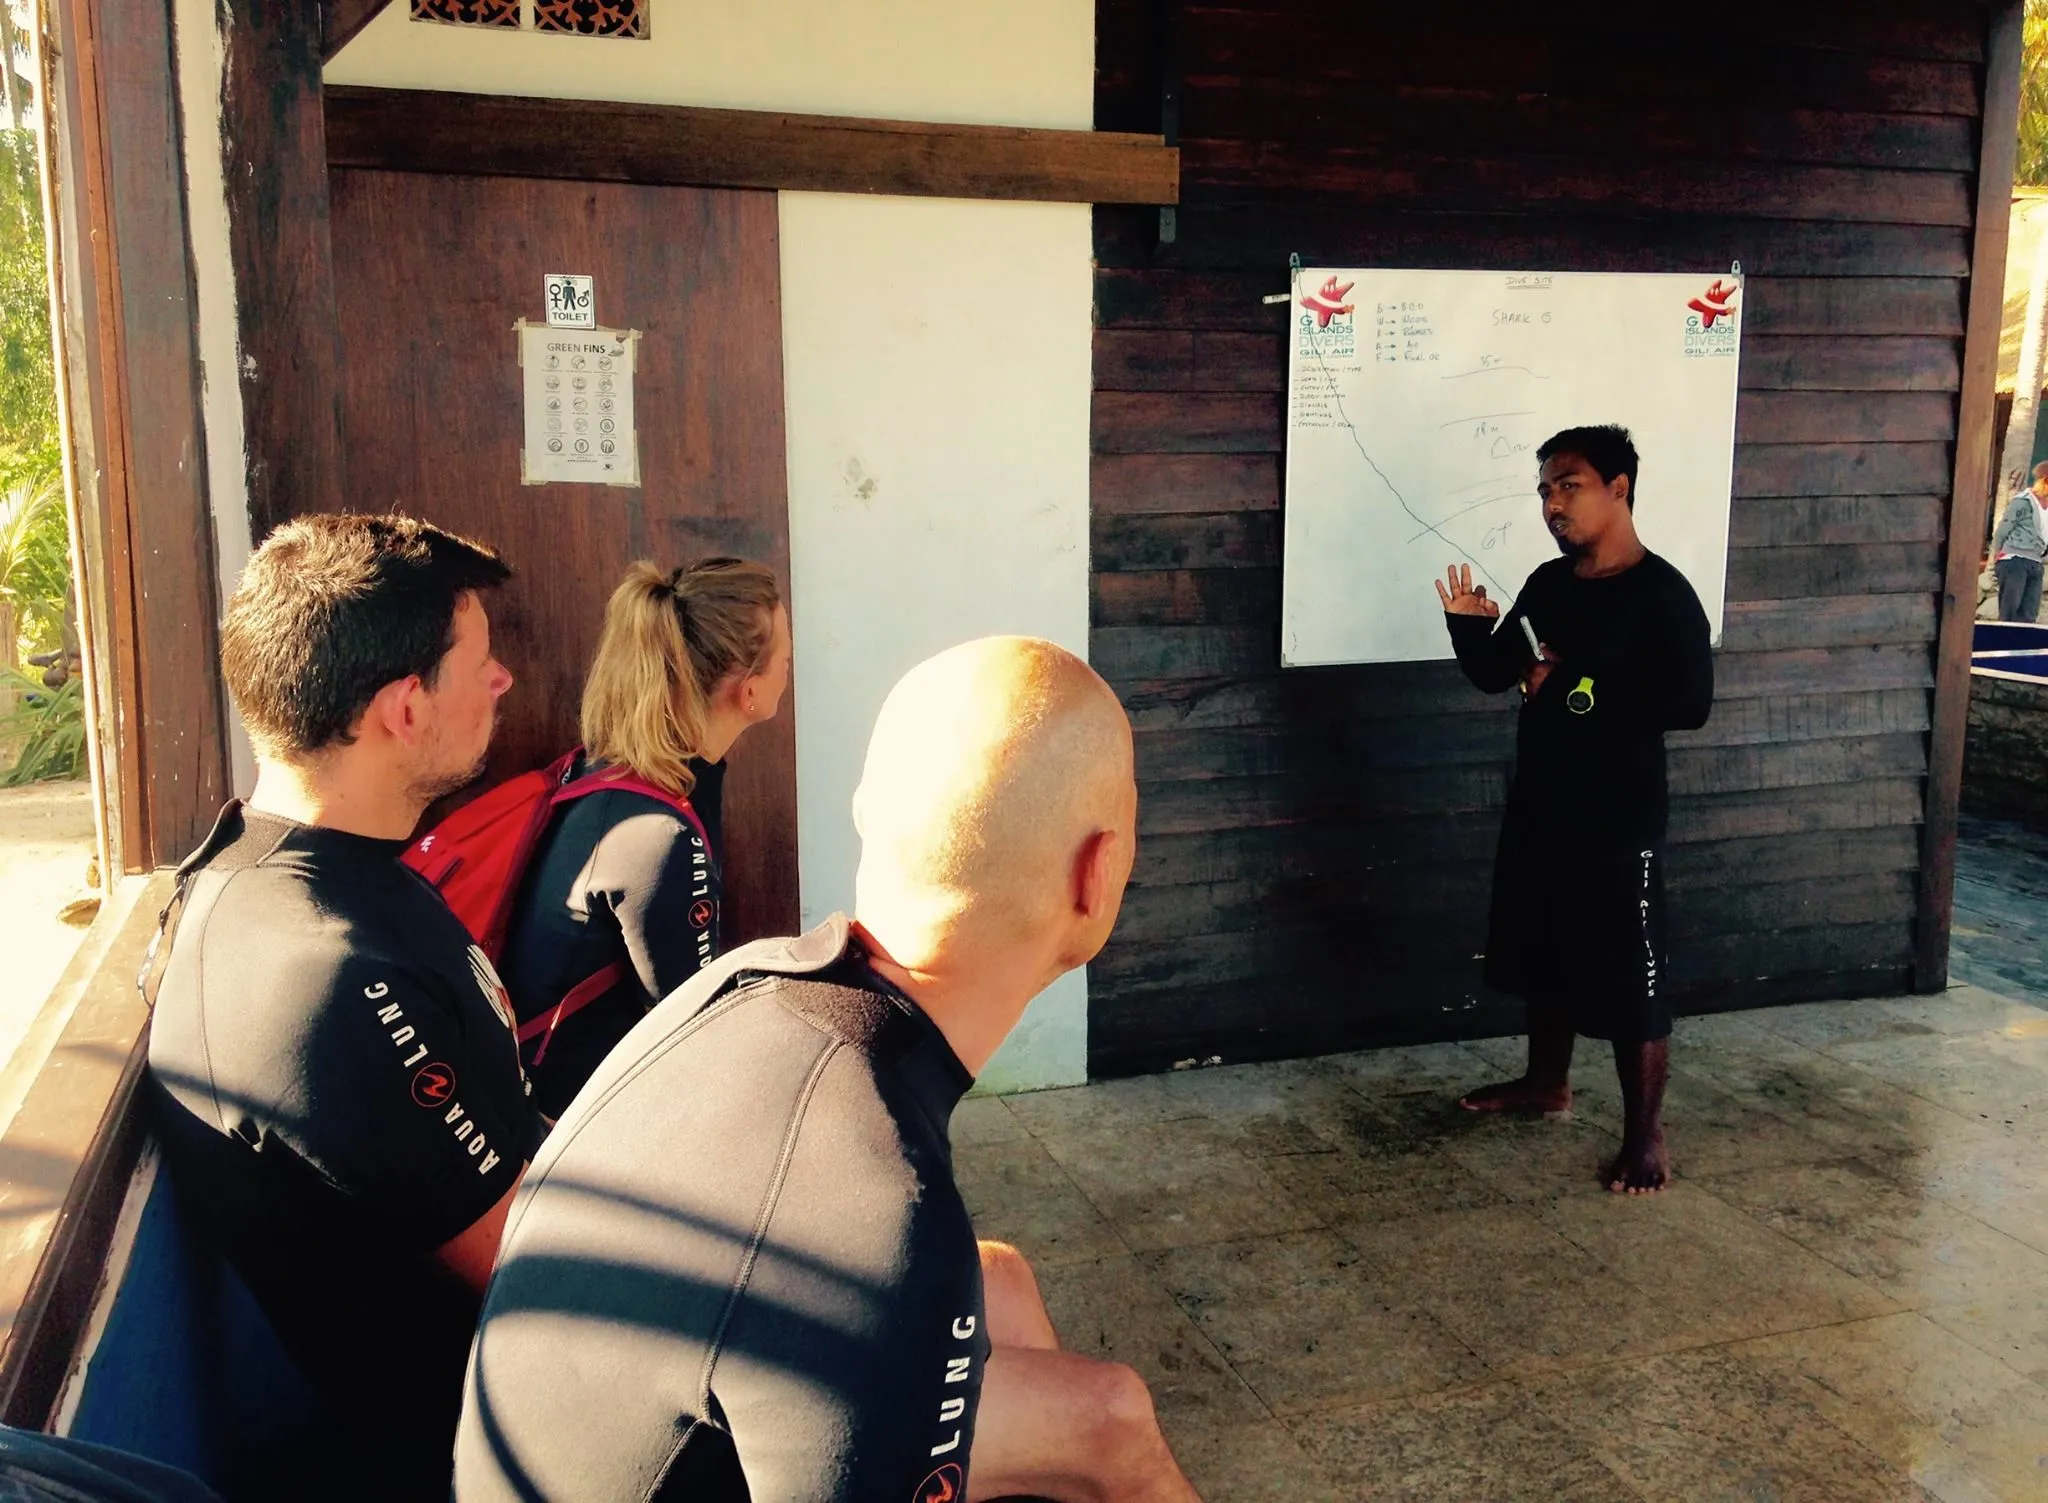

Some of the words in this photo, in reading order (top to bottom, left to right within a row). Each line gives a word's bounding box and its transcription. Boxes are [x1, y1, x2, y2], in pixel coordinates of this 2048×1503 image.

[552, 312, 588, 321] TOILET
[1492, 309, 1530, 326] SHARK
[1299, 326, 1353, 335] ISLANDS
[1685, 327, 1735, 335] ISLANDS
[1299, 336, 1354, 347] DIVERS
[1685, 335, 1735, 346] DIVERS
[547, 342, 581, 353] GREEN
[583, 344, 606, 353] FINS
[691, 837, 708, 896] LUNG
[364, 981, 429, 1068] LUNG
[444, 1102, 501, 1176] AQUA
[930, 1315, 976, 1457] LUNG
